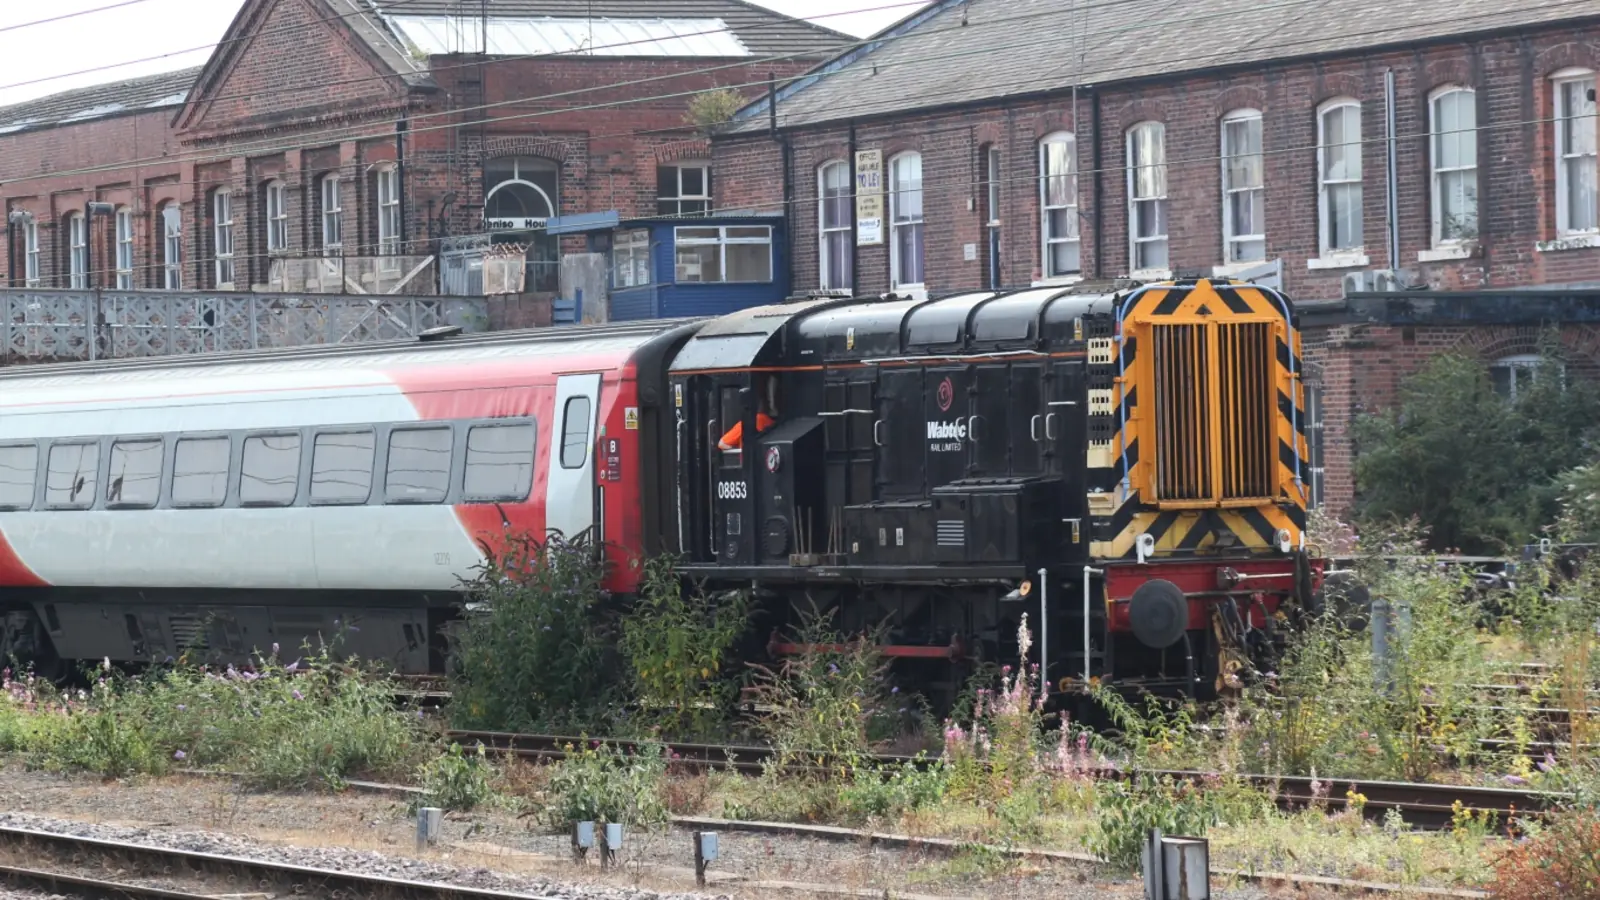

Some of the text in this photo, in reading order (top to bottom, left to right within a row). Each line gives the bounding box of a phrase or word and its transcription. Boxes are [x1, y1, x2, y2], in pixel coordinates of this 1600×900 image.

[857, 172, 881, 188] TO LET
[524, 218, 547, 229] Hou
[927, 420, 967, 439] Wabtec
[718, 481, 747, 499] 08853
